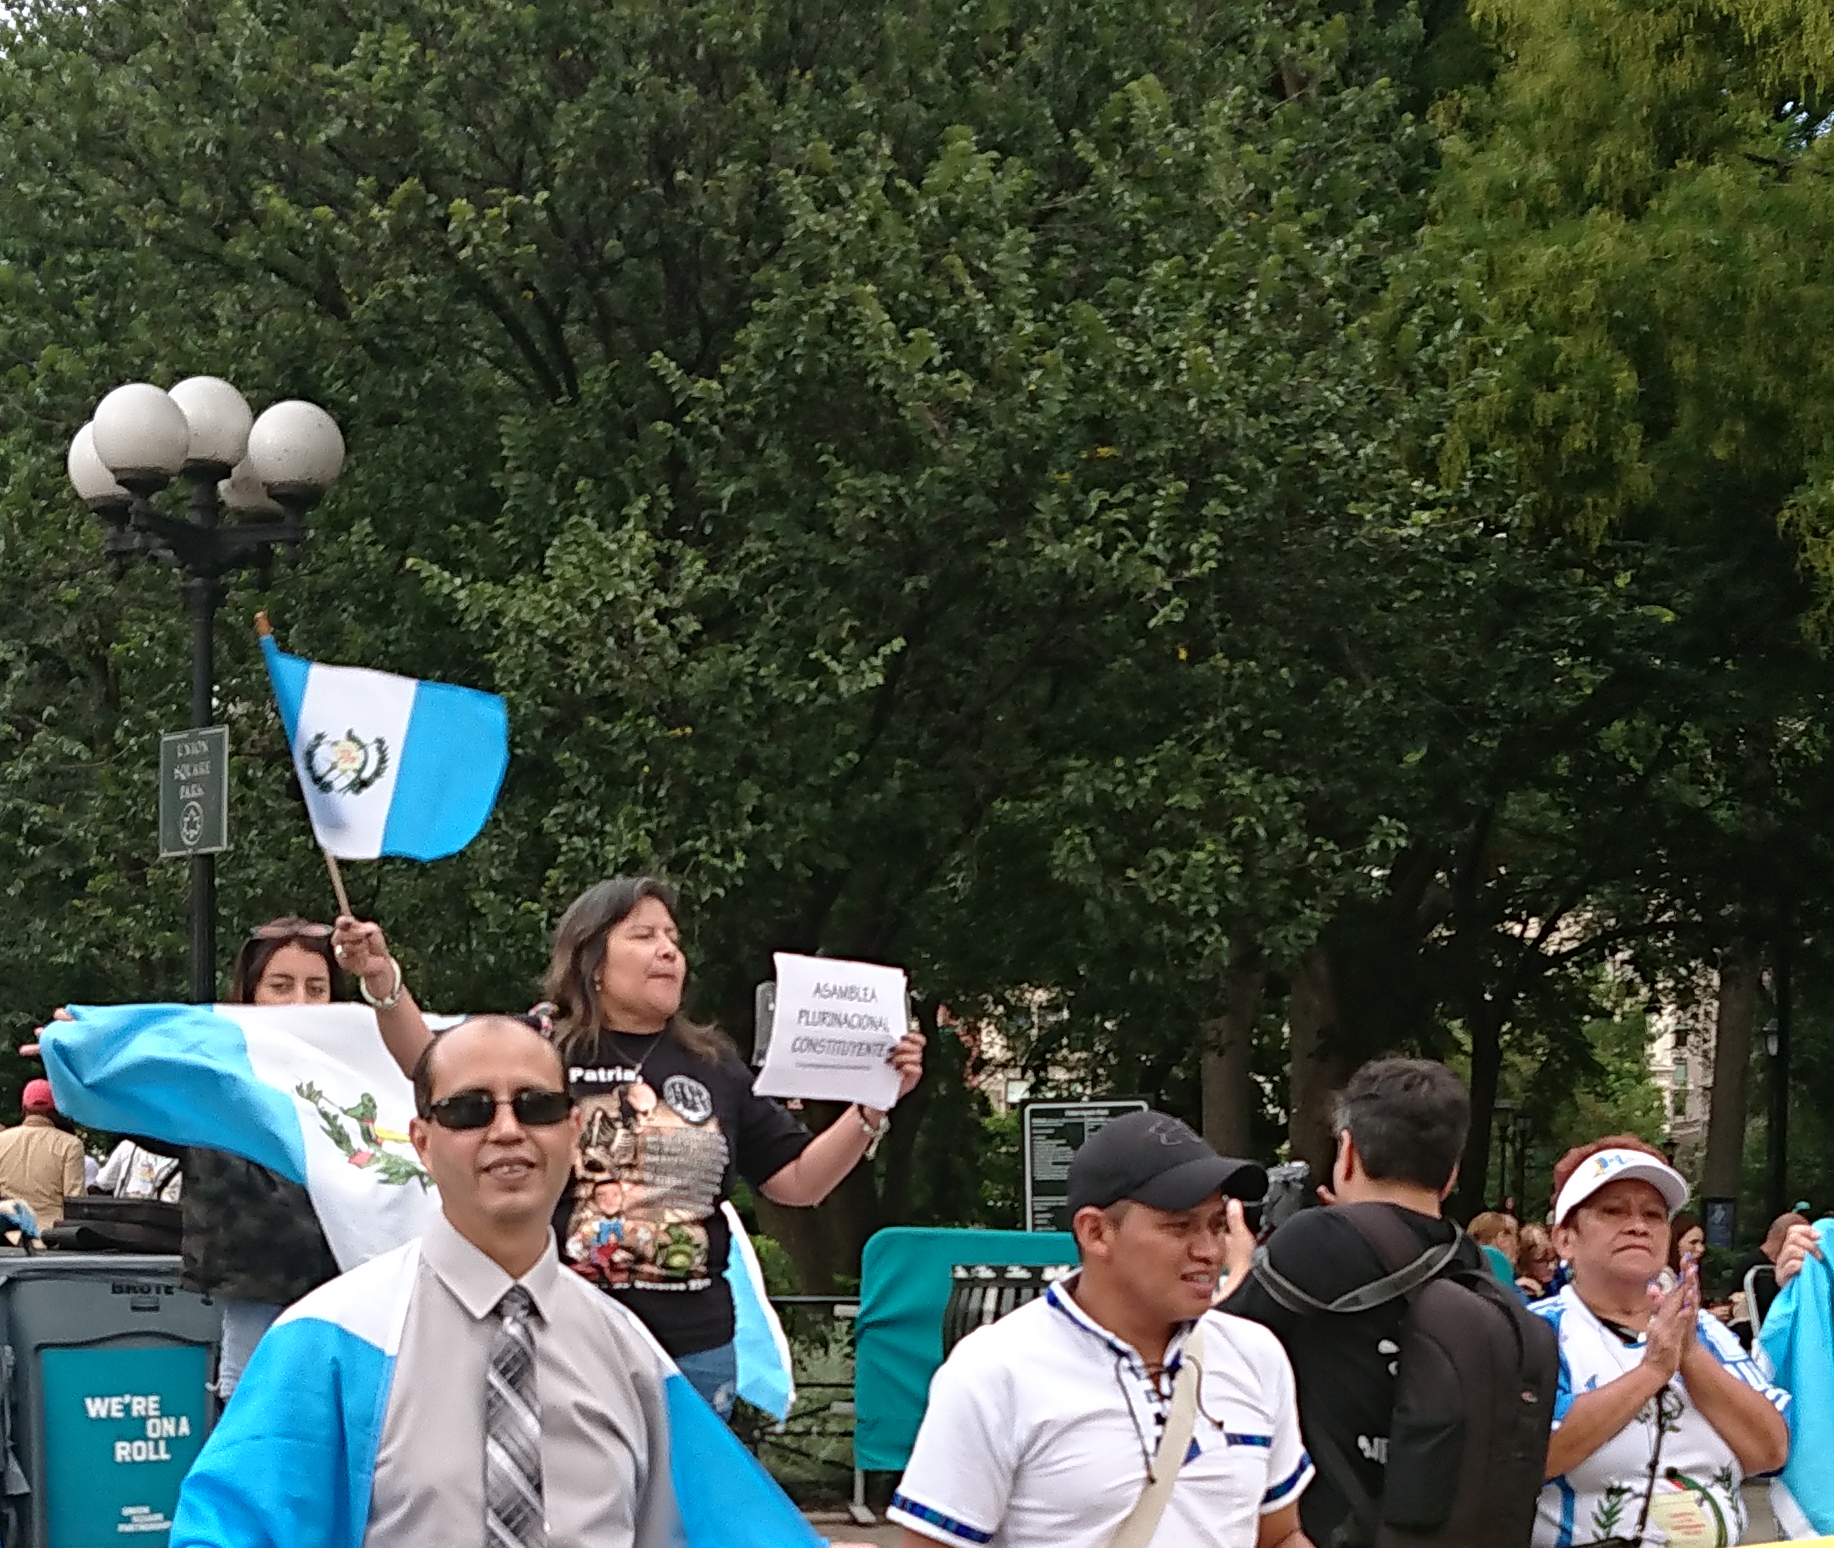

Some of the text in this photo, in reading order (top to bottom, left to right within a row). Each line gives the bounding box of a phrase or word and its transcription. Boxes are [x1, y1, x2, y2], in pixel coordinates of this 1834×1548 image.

[811, 981, 878, 1004] ASAMBLEA
[568, 1065, 644, 1084] Patria,
[84, 1393, 162, 1419] WE'RE
[146, 1415, 191, 1439] ON A
[113, 1440, 172, 1463] ROLL
